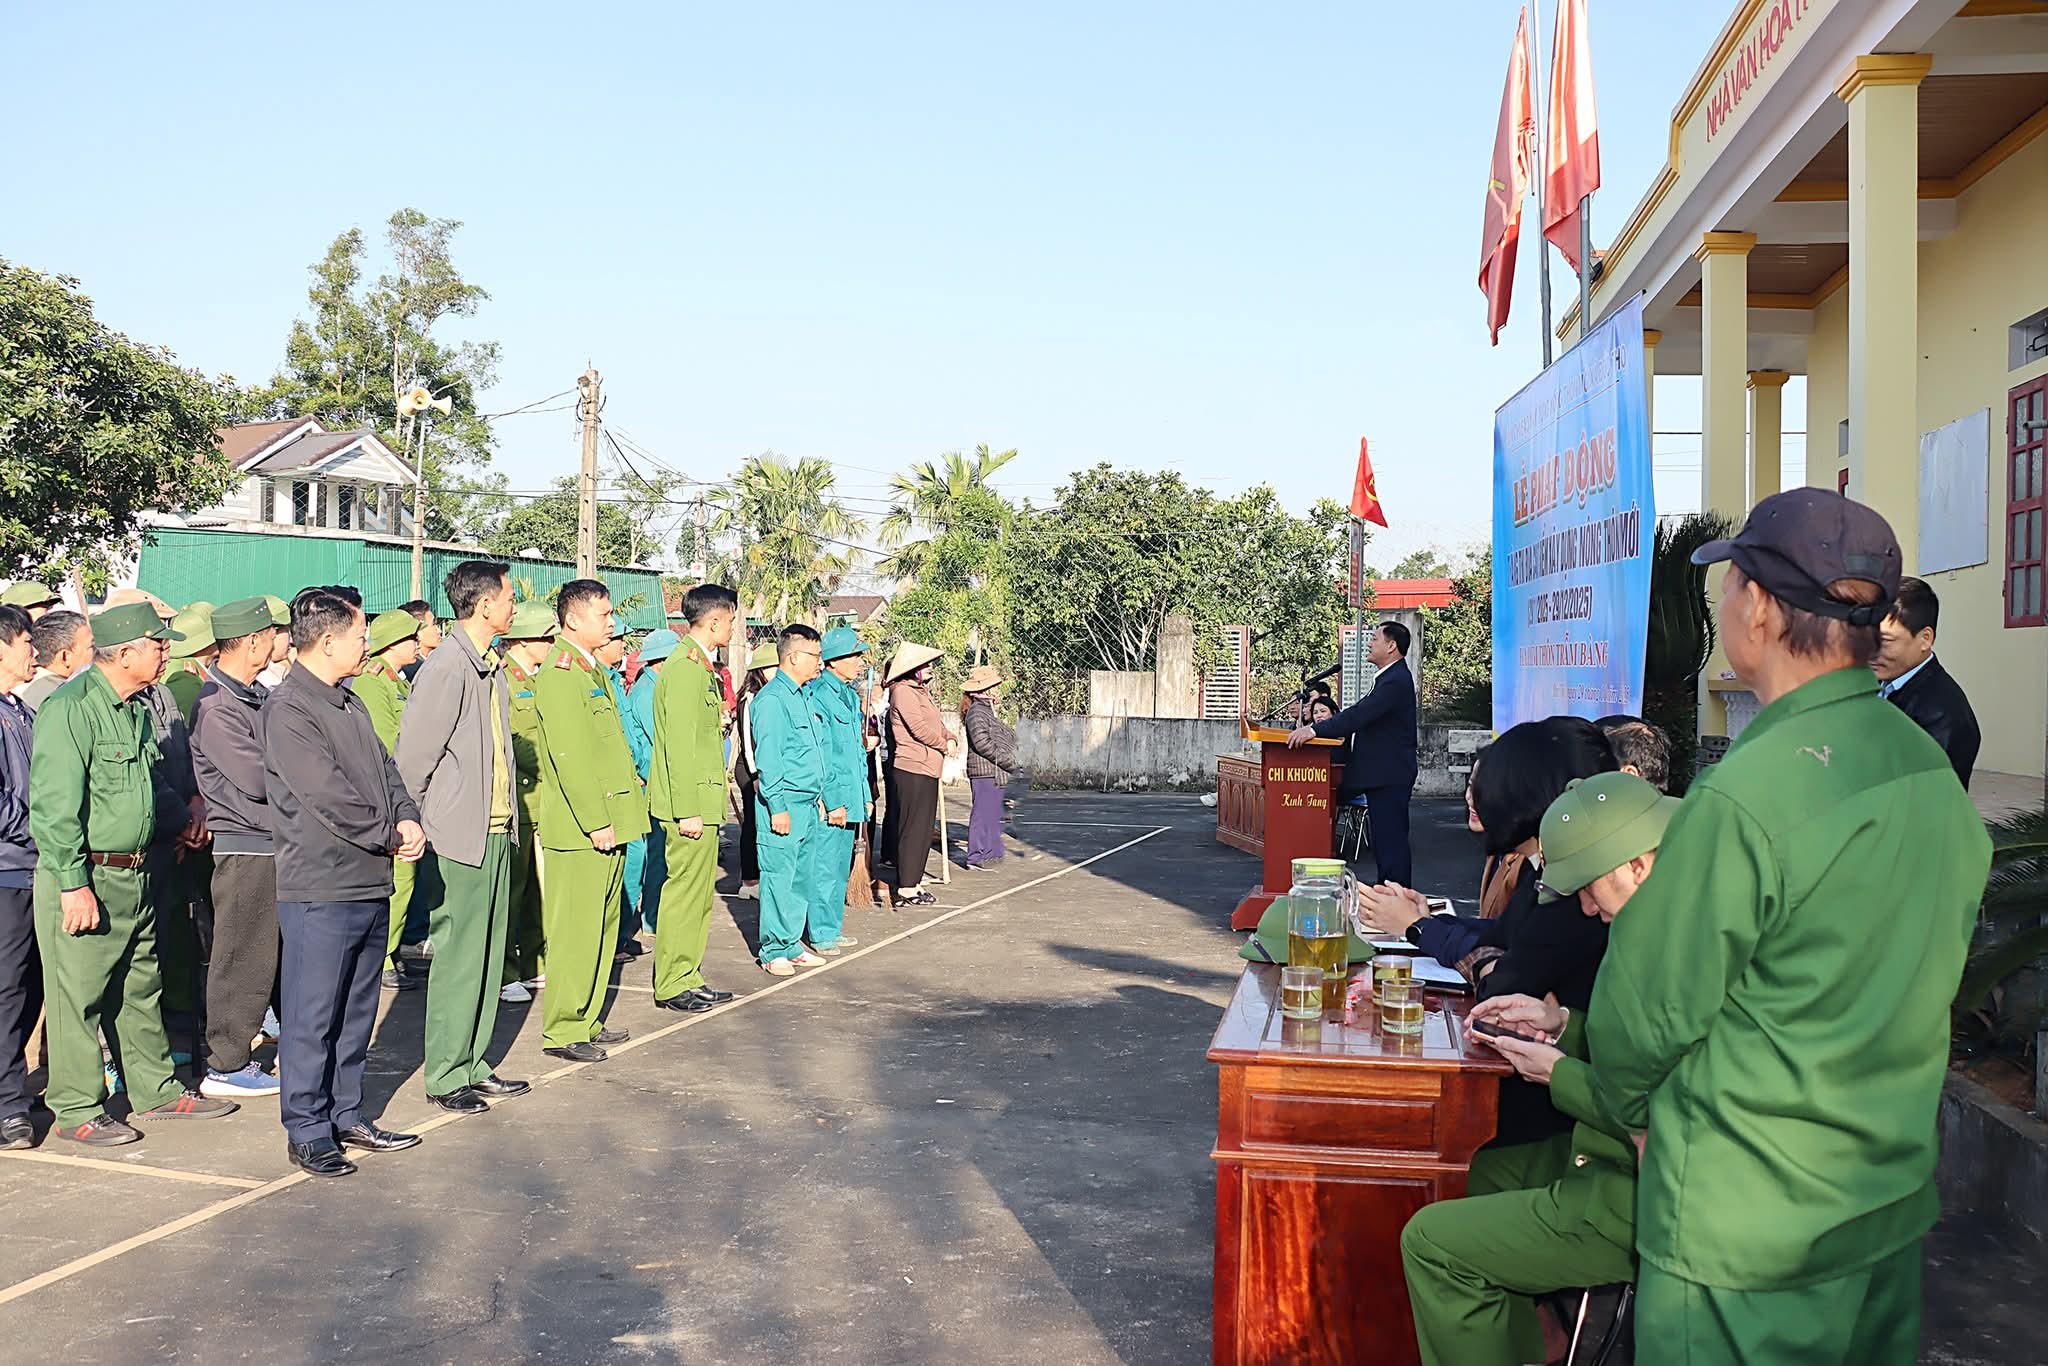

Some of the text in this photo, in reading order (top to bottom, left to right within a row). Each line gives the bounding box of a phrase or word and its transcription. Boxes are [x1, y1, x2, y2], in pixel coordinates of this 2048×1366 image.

[1707, 71, 1733, 142] NHÀ
[1731, 36, 1758, 105] VĂN
[1579, 516, 1601, 567] NÔNG
[1580, 634, 1608, 668] BÀNG
[1287, 766, 1327, 782] KHƯƠNG
